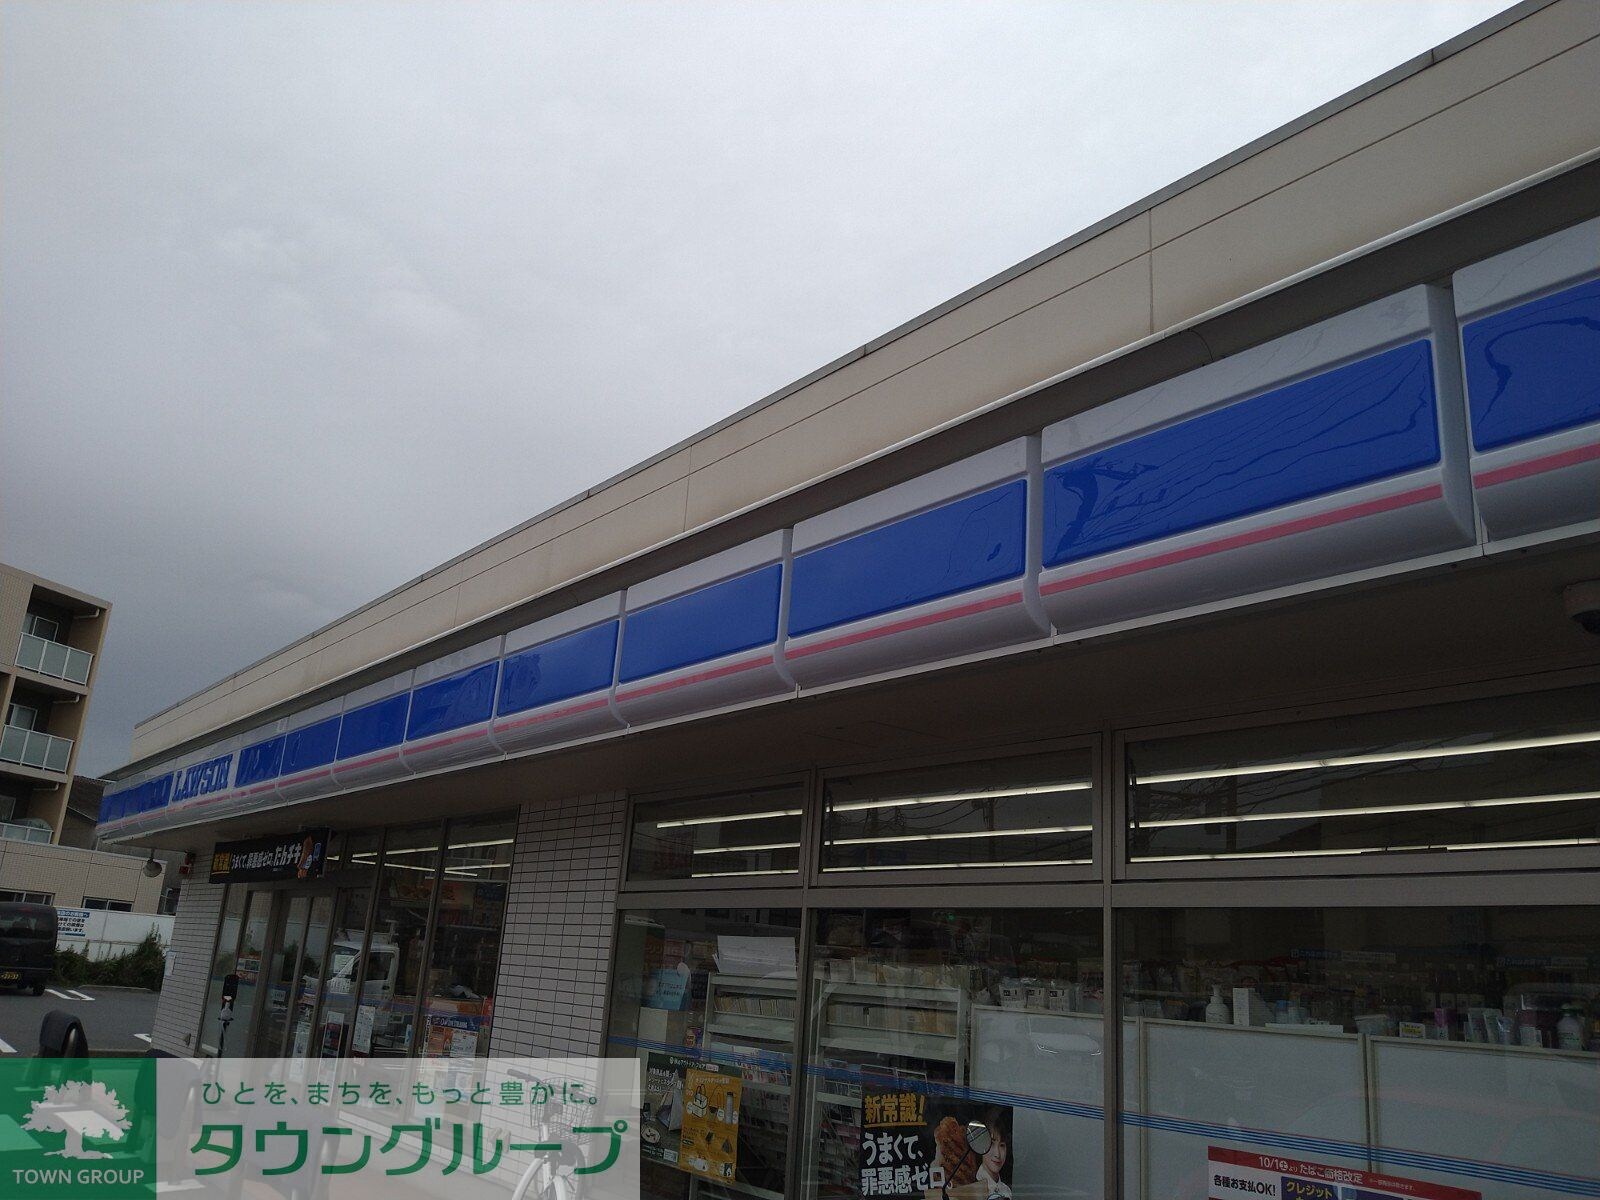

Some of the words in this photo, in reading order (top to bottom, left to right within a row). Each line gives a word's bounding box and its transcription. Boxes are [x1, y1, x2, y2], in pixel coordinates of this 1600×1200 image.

[172, 754, 233, 802] LAWSON
[864, 1091, 926, 1122] 新常識!
[862, 1132, 923, 1165] うまくて、
[1213, 1174, 1276, 1197] 各種お支払OK!
[1286, 1181, 1333, 1198] クレジット
